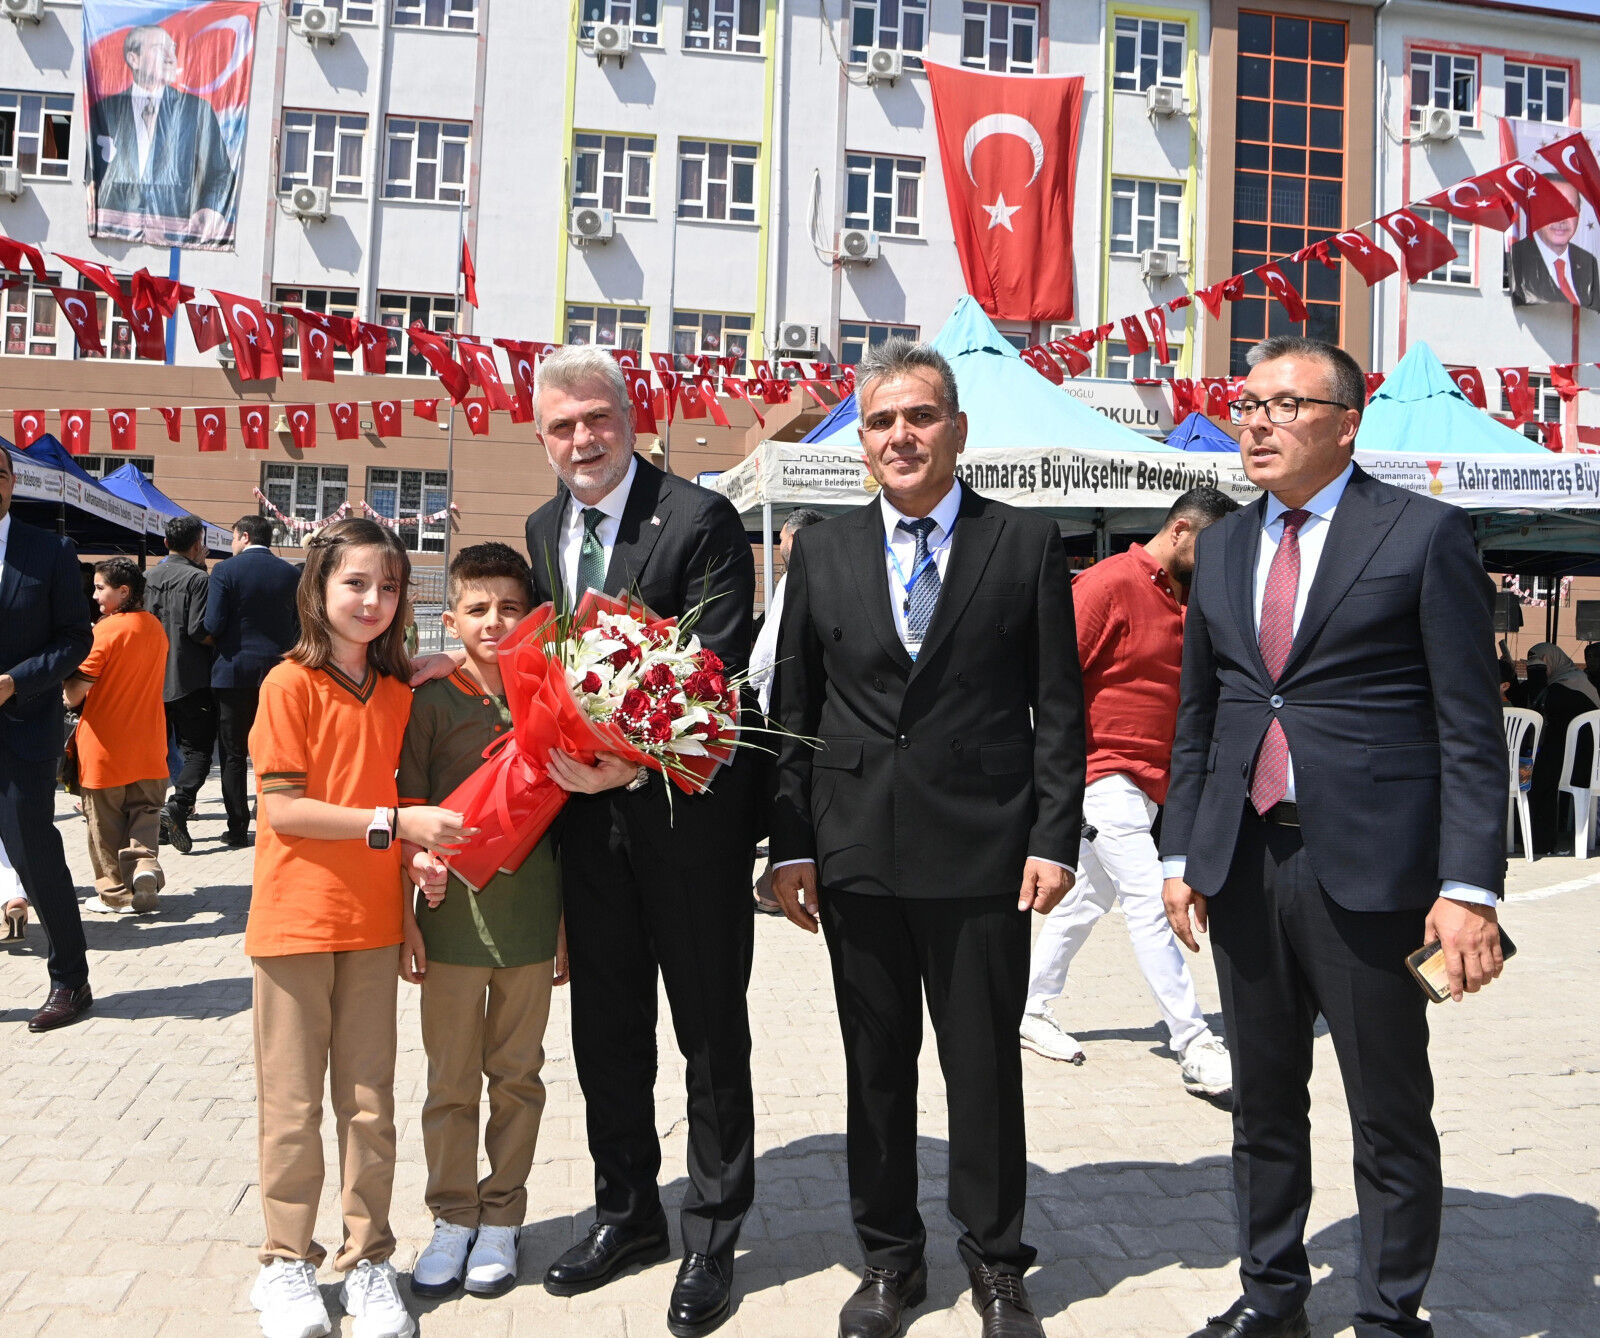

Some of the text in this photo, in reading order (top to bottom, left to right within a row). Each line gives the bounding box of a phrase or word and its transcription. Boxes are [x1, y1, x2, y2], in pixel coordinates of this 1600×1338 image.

[783, 466, 860, 476] Kahramanmaraş
[1041, 456, 1133, 496] Büyükşehir
[1137, 461, 1219, 490] Belediyesi
[1456, 461, 1573, 495] Kahramanmaraş
[782, 478, 861, 487] Büyükşehir Belediyesi
